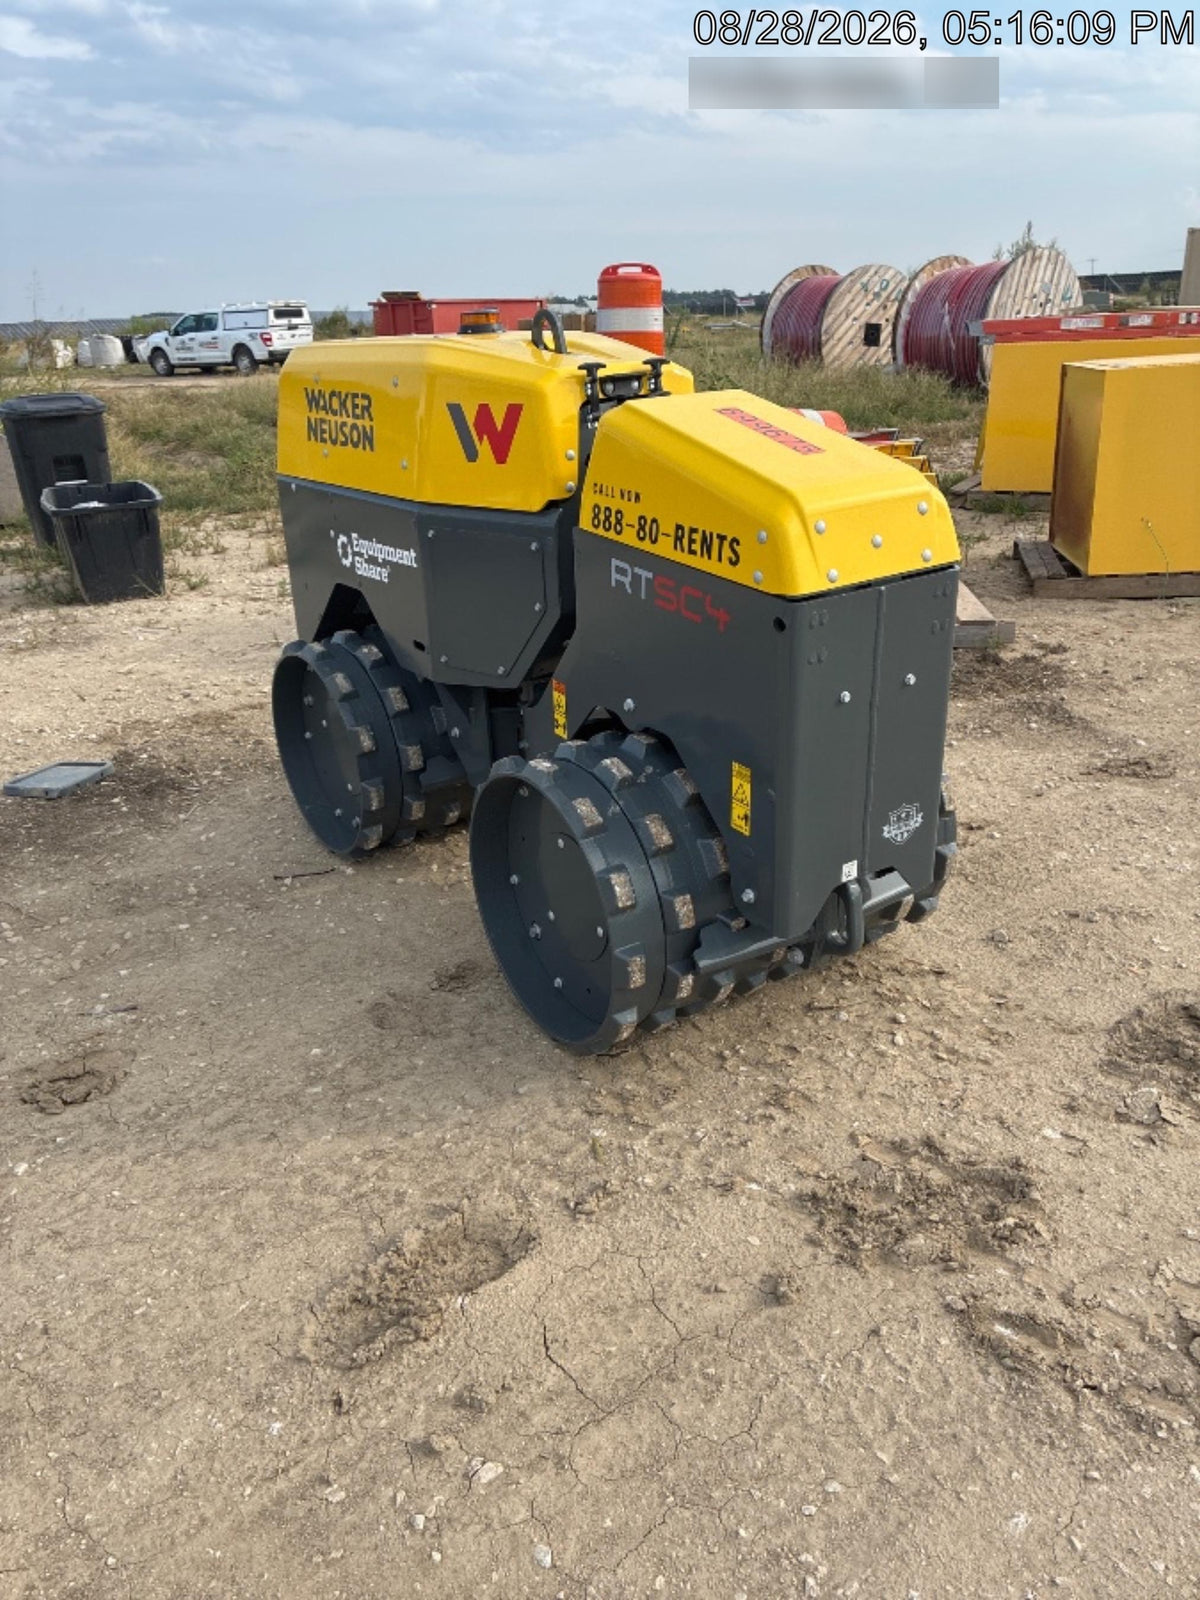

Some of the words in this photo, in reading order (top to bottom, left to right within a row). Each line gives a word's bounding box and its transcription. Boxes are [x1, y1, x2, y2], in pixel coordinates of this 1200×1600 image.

[304, 387, 374, 422] WACKER
[307, 416, 374, 452] NEUSON
[351, 532, 418, 568] Equipment
[592, 503, 741, 567] 888-80-RENTS
[610, 557, 732, 633] RTSC4
